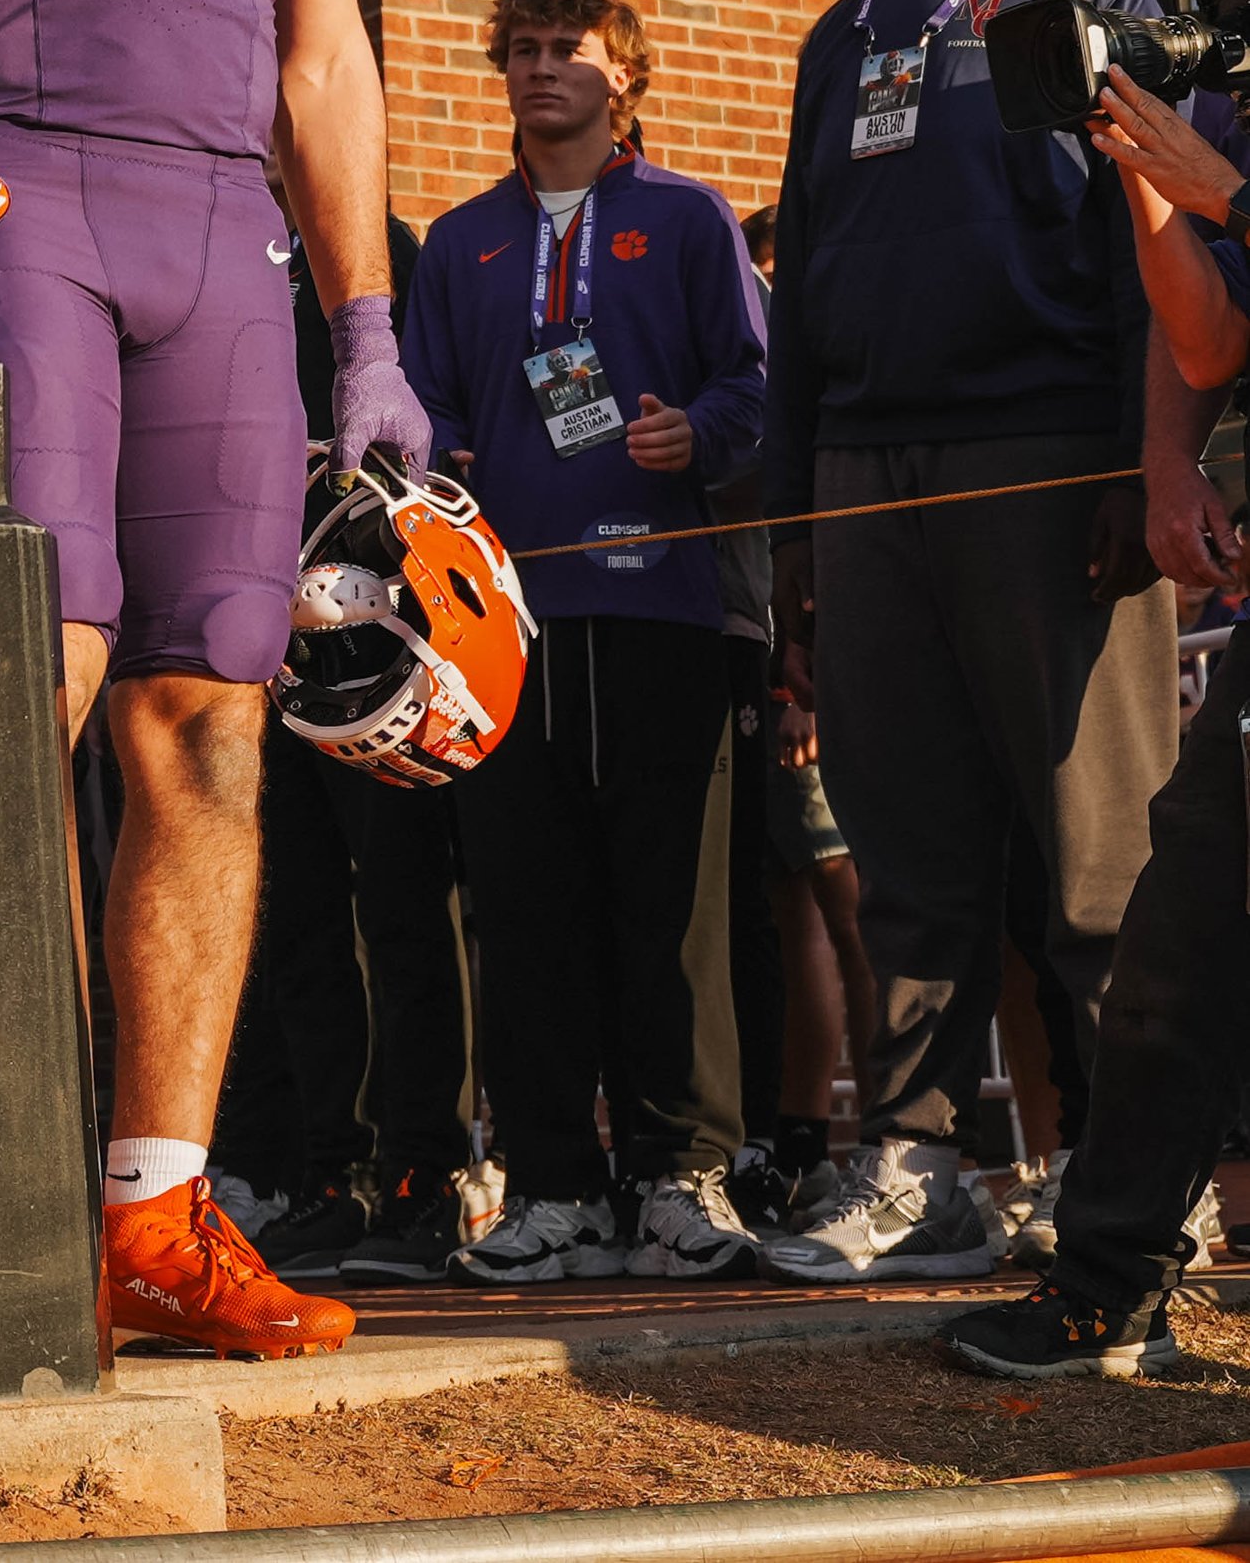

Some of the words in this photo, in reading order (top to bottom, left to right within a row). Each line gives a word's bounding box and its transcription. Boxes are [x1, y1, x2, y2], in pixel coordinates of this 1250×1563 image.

[947, 40, 986, 48] FOOTBA
[866, 111, 907, 130] AUSTIN
[866, 120, 905, 140] BALLOU
[537, 223, 551, 267] CLEMSON
[579, 225, 592, 267] CLEMSON
[561, 411, 613, 440] CRISTIAAN
[563, 404, 602, 428] AUSTAN
[597, 524, 650, 536] CLEMSON
[607, 555, 644, 569] FOOTBALL
[125, 1277, 186, 1316] ALPHA
